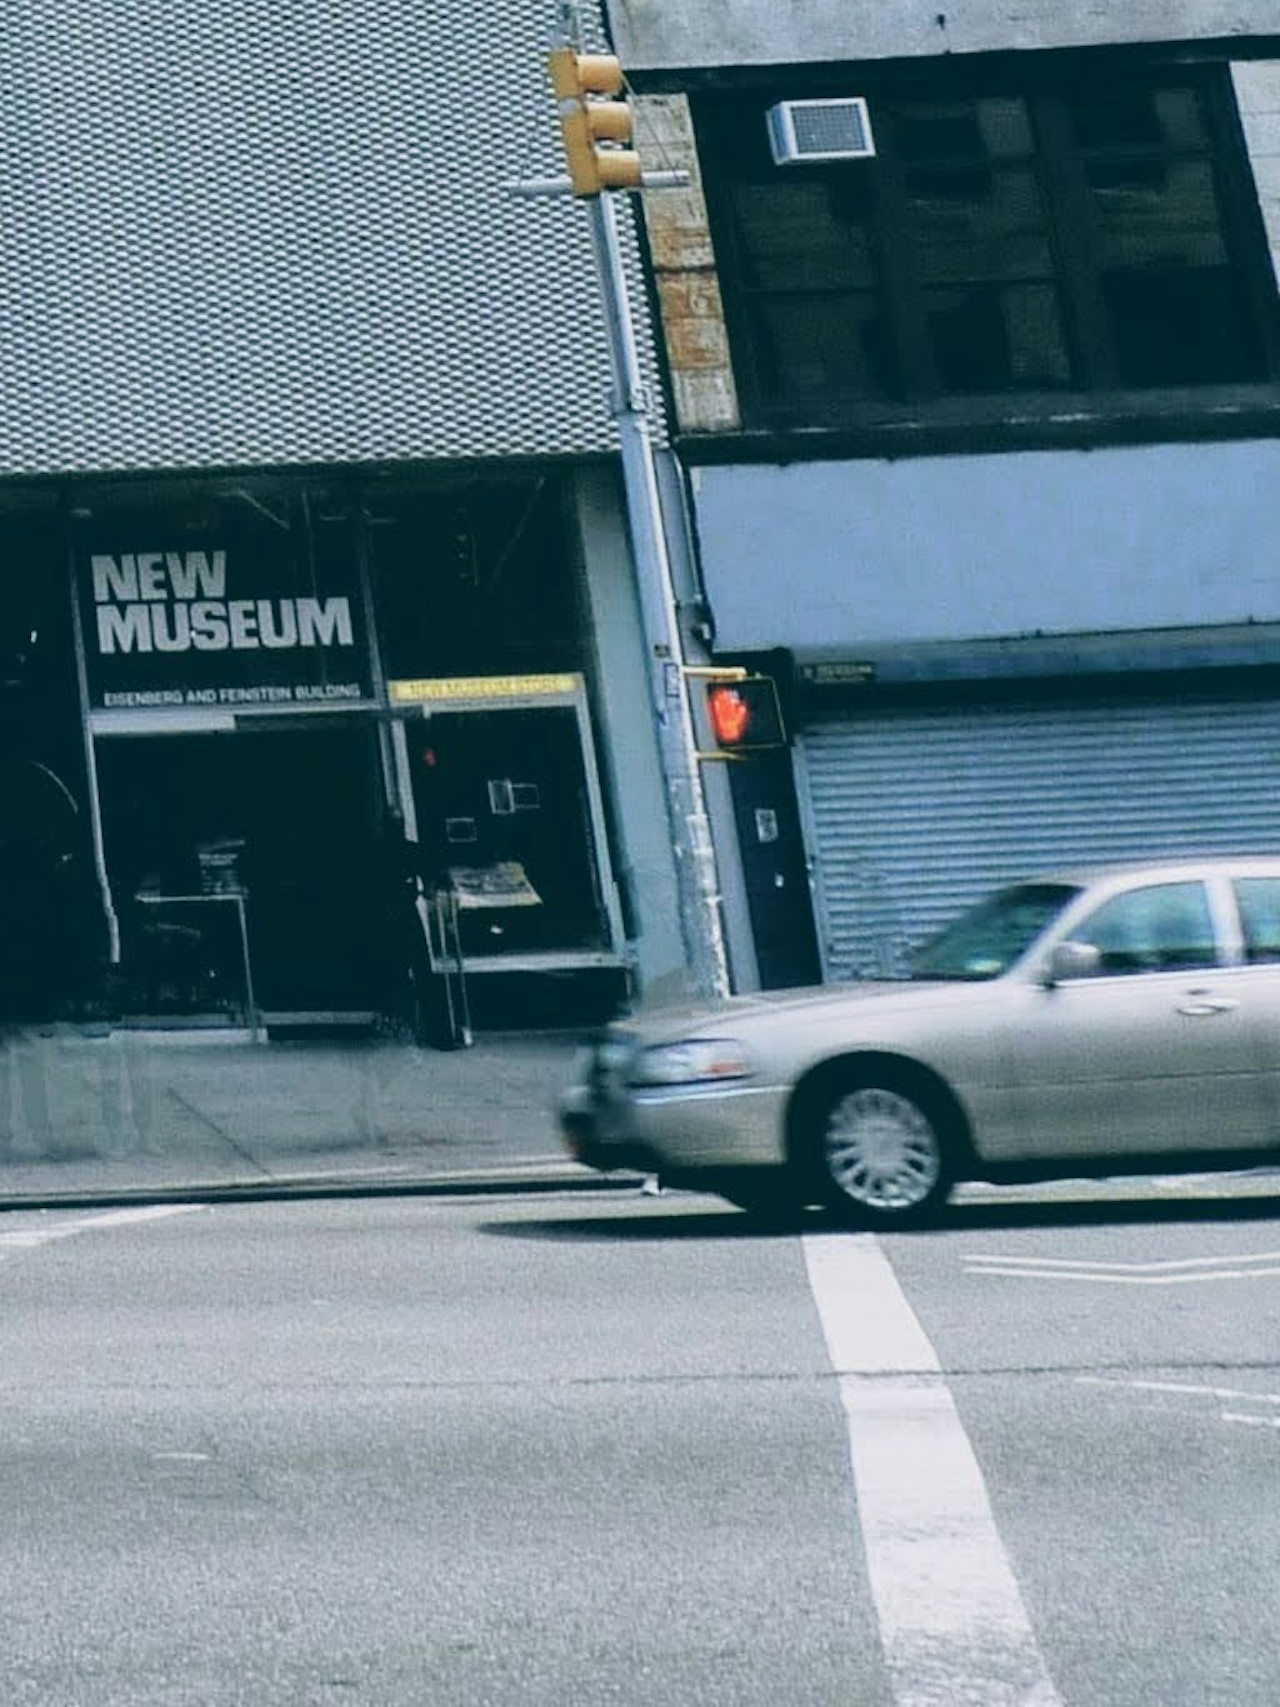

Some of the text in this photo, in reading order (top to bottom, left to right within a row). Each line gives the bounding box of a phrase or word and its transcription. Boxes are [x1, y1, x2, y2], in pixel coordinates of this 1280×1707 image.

[91, 550, 227, 602] NEW
[96, 597, 354, 654] MUSEUM
[104, 683, 361, 706] EISENBERG AND FEINSTEIN BUILDING
